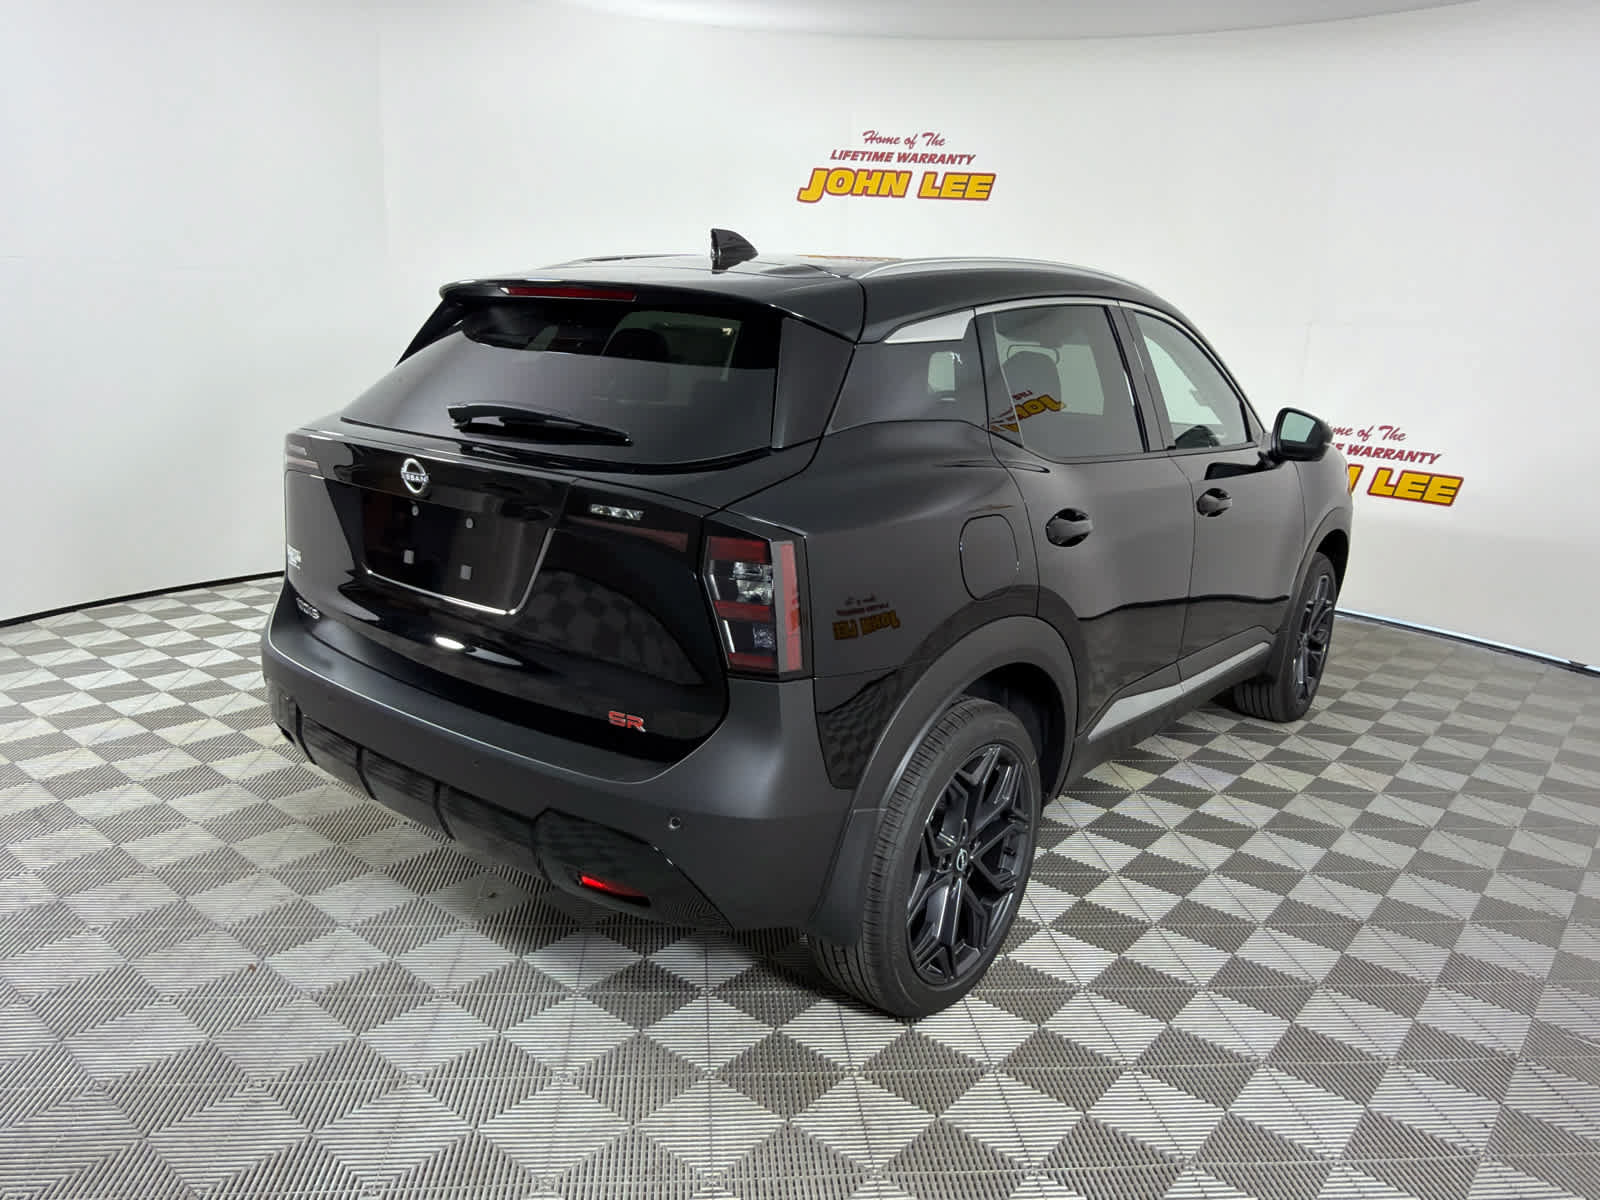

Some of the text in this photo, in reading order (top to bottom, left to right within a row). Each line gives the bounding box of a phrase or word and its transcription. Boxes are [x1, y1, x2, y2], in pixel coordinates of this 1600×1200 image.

[862, 129, 946, 149] Home of The
[830, 149, 976, 165] LIFETIME WARRANTY
[797, 167, 996, 204] JOHN LEE
[1357, 425, 1374, 442] of
[1378, 425, 1407, 442] The
[1347, 443, 1442, 465] WARRANTY
[1366, 467, 1464, 507] LEE
[608, 711, 646, 733] SR
